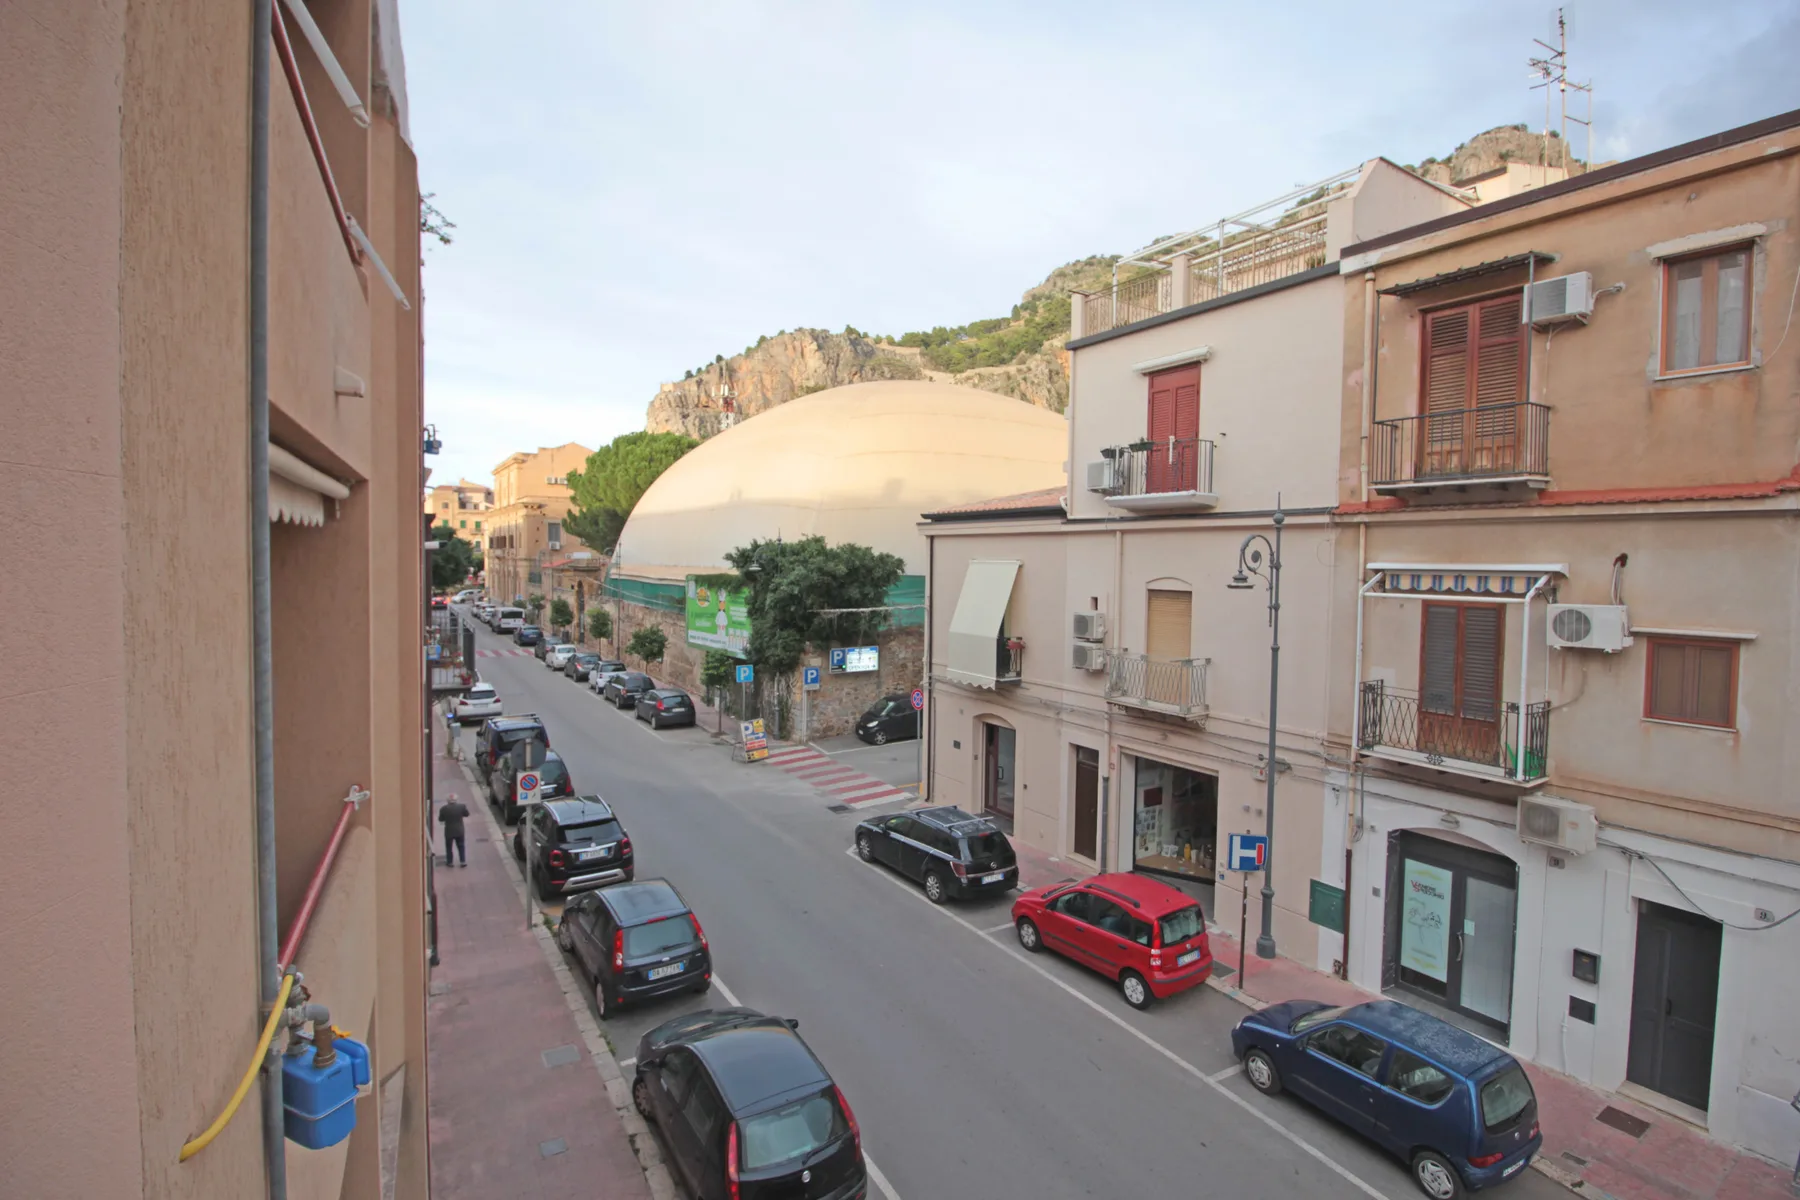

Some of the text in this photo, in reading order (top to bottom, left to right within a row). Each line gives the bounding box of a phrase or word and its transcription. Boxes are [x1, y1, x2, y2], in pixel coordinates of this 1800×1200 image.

[833, 650, 843, 664] P
[740, 667, 749, 681] P
[807, 669, 817, 683] P
